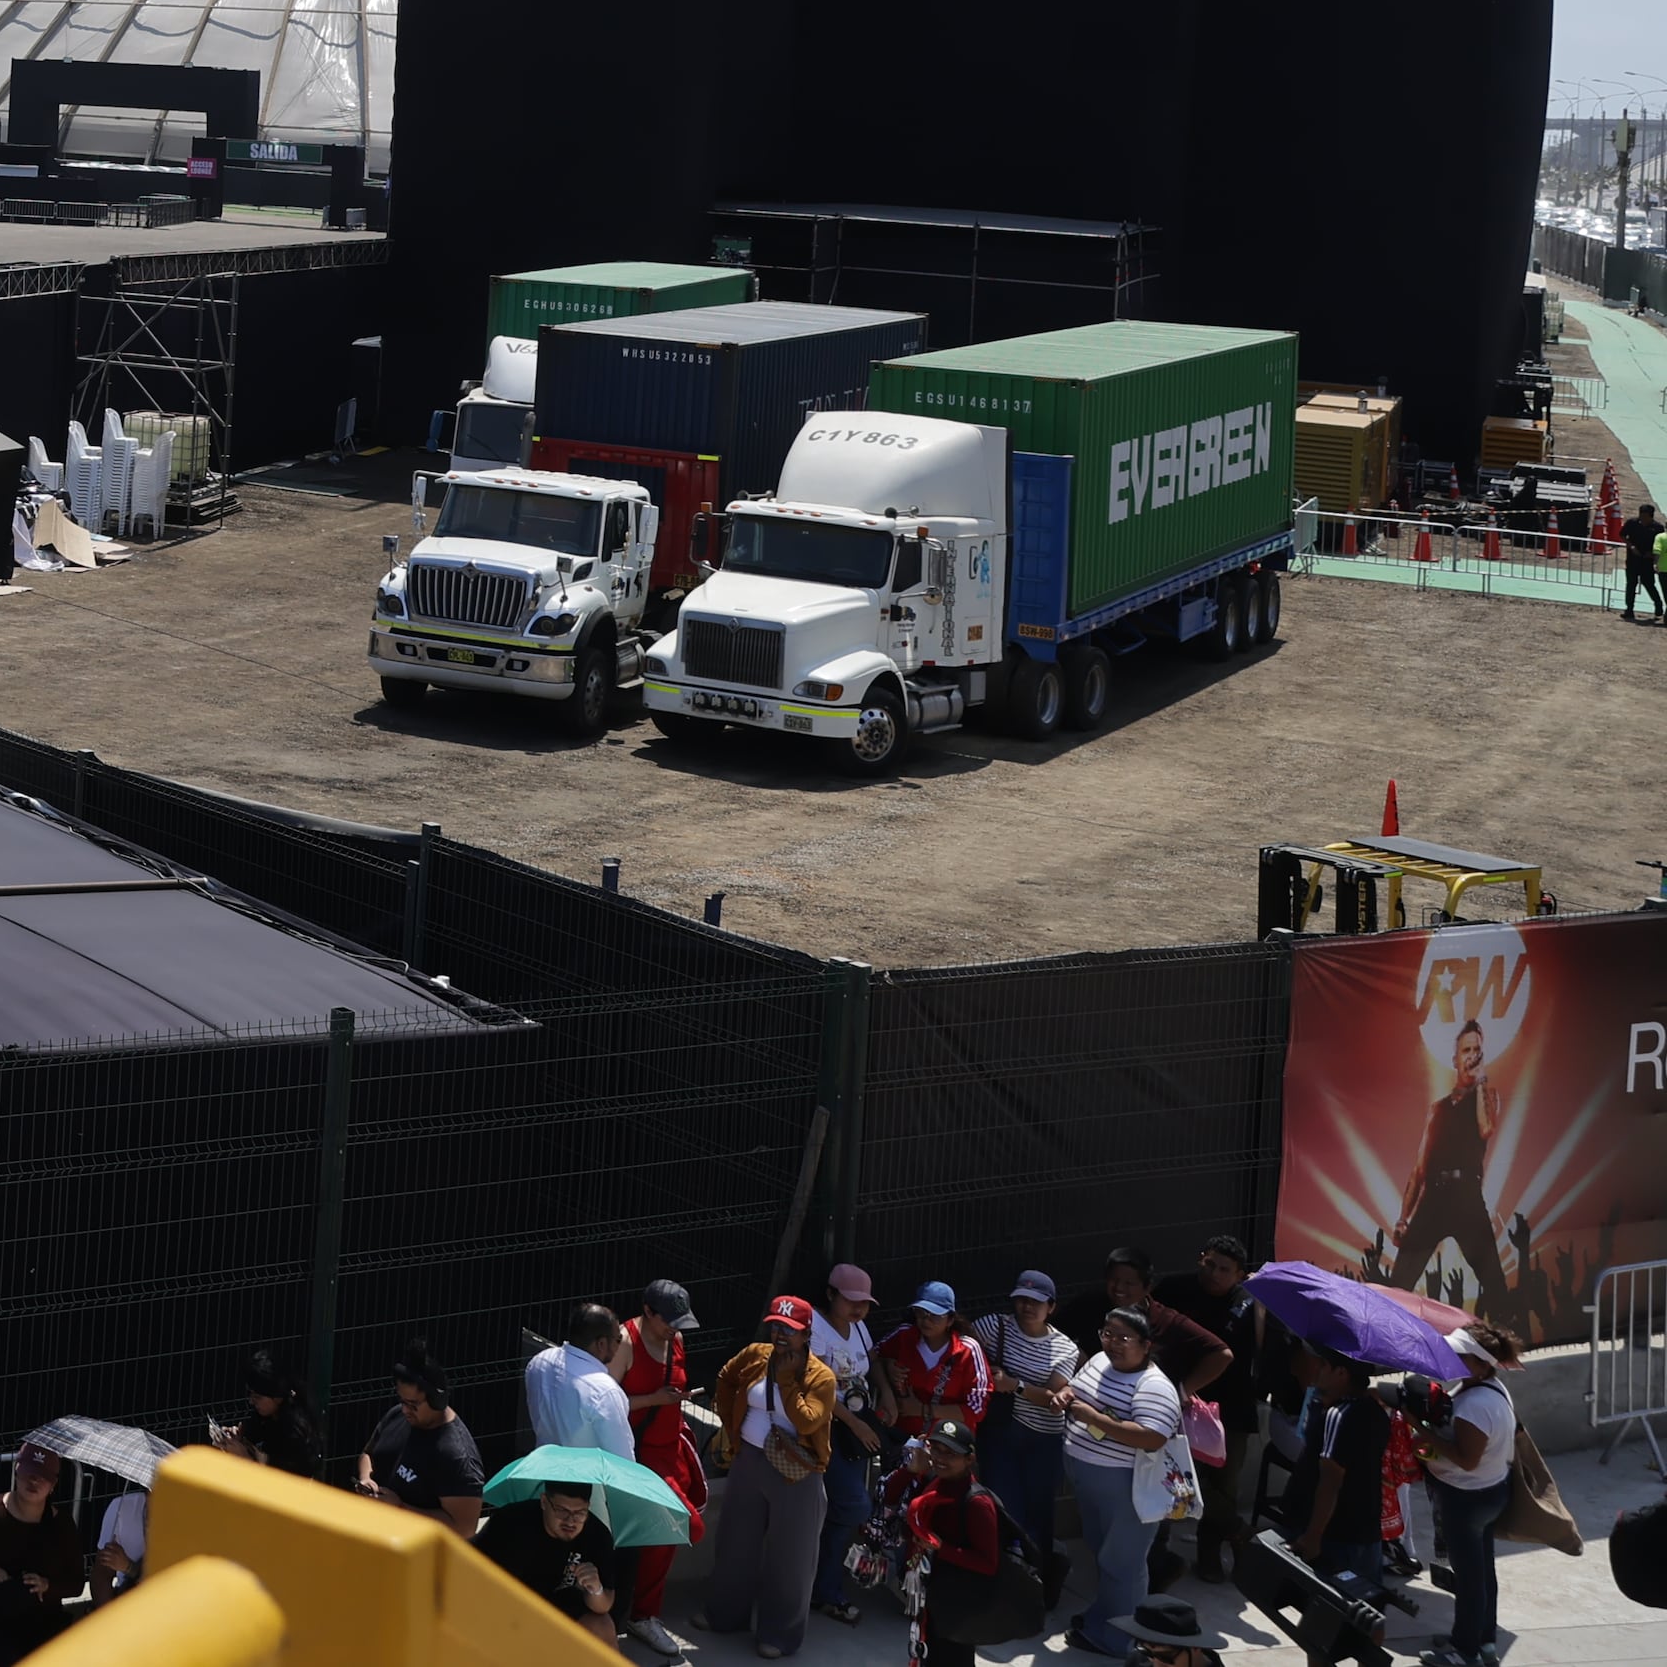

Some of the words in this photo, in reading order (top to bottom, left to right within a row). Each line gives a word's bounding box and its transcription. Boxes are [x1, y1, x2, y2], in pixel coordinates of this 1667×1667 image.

[250, 143, 298, 161] SALIDA
[1108, 402, 1272, 525] EVERGREEN
[1627, 1021, 1667, 1092] R
